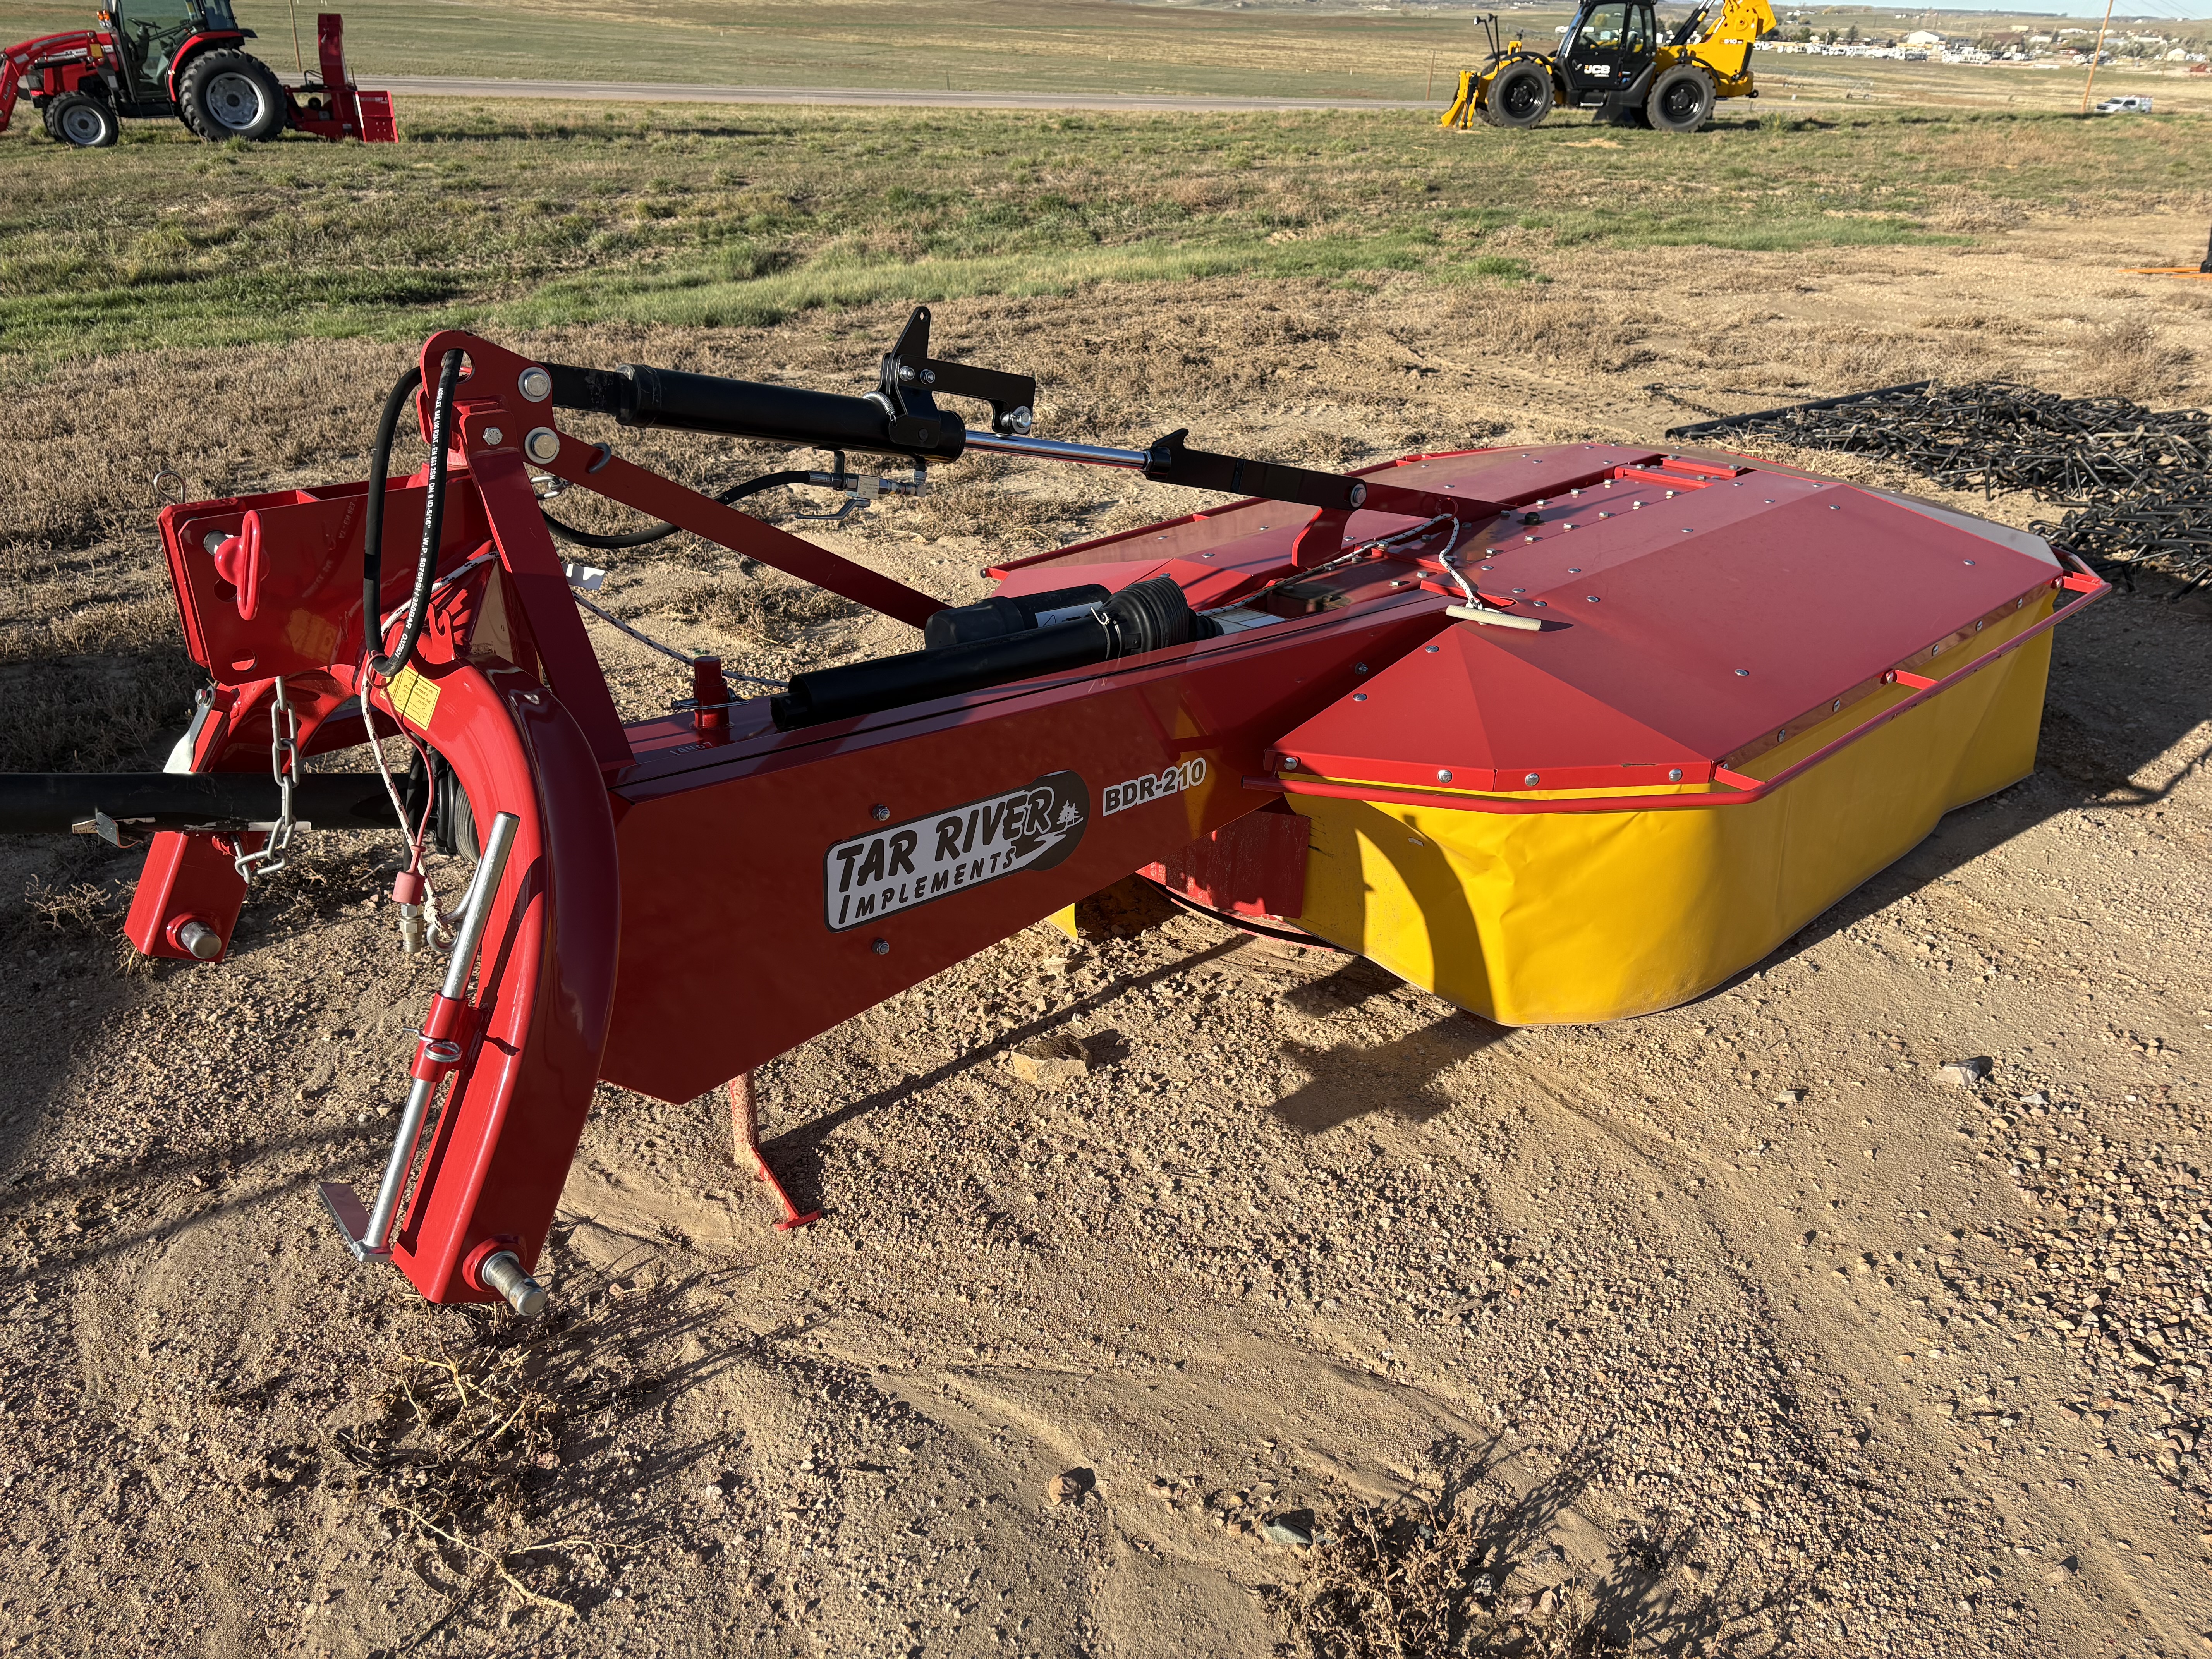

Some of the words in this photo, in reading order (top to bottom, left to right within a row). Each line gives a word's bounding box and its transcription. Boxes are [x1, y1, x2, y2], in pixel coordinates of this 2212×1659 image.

[1584, 65, 1611, 74] JCB
[431, 447, 438, 456] EN
[428, 483, 435, 493] DN
[415, 557, 426, 591] 5075PSI
[405, 596, 419, 629] 350BAR
[1103, 758, 1206, 816] BDR-210
[836, 830, 918, 893] TAR
[934, 788, 1053, 862] RIVER
[838, 847, 1015, 924] IMPLEMENTS
